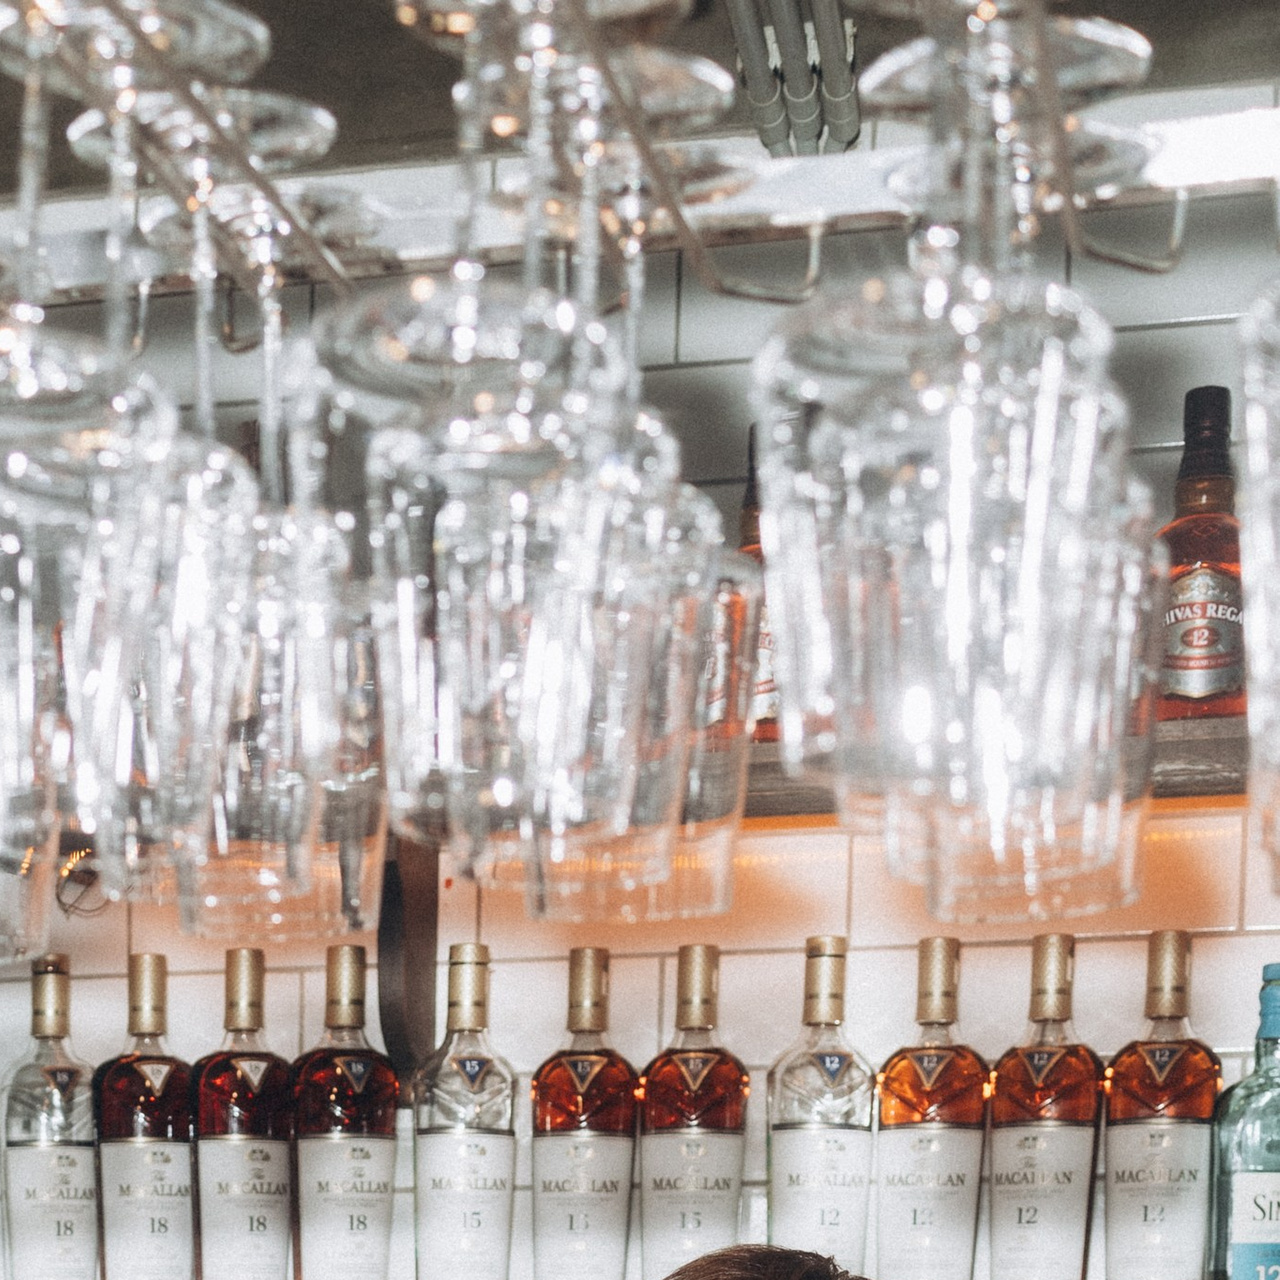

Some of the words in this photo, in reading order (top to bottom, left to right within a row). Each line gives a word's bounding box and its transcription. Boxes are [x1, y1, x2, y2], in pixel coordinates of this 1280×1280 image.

[1162, 604, 1202, 625] HIVAS
[1206, 603, 1243, 625] REGA
[1192, 628, 1209, 646] 12
[825, 1056, 839, 1068] 12
[923, 1056, 937, 1067] 12
[1033, 1054, 1048, 1065] 12
[1155, 1050, 1169, 1061] 12
[350, 1062, 364, 1073] 18
[465, 1060, 479, 1071] 15
[787, 1174, 865, 1187] MALLAN
[886, 1173, 966, 1187] MACALAN
[995, 1171, 1073, 1185] MACALAN
[1114, 1169, 1199, 1184] MACALAN
[119, 1184, 191, 1197] MALLAN
[217, 1182, 289, 1195] MCALLAN
[317, 1181, 390, 1194] MCALLAN
[431, 1178, 507, 1190] MALLAN
[541, 1179, 620, 1193] MACLAN
[652, 1177, 732, 1191] MACLAN
[25, 1187, 95, 1200] MALLAN
[1252, 1194, 1280, 1221] SI
[348, 1214, 368, 1231] 18
[462, 1211, 482, 1229] 15
[819, 1208, 840, 1227] 12
[1016, 1207, 1039, 1225] 12
[55, 1220, 74, 1237] 18
[150, 1217, 169, 1234] 18
[248, 1215, 268, 1232] 18
